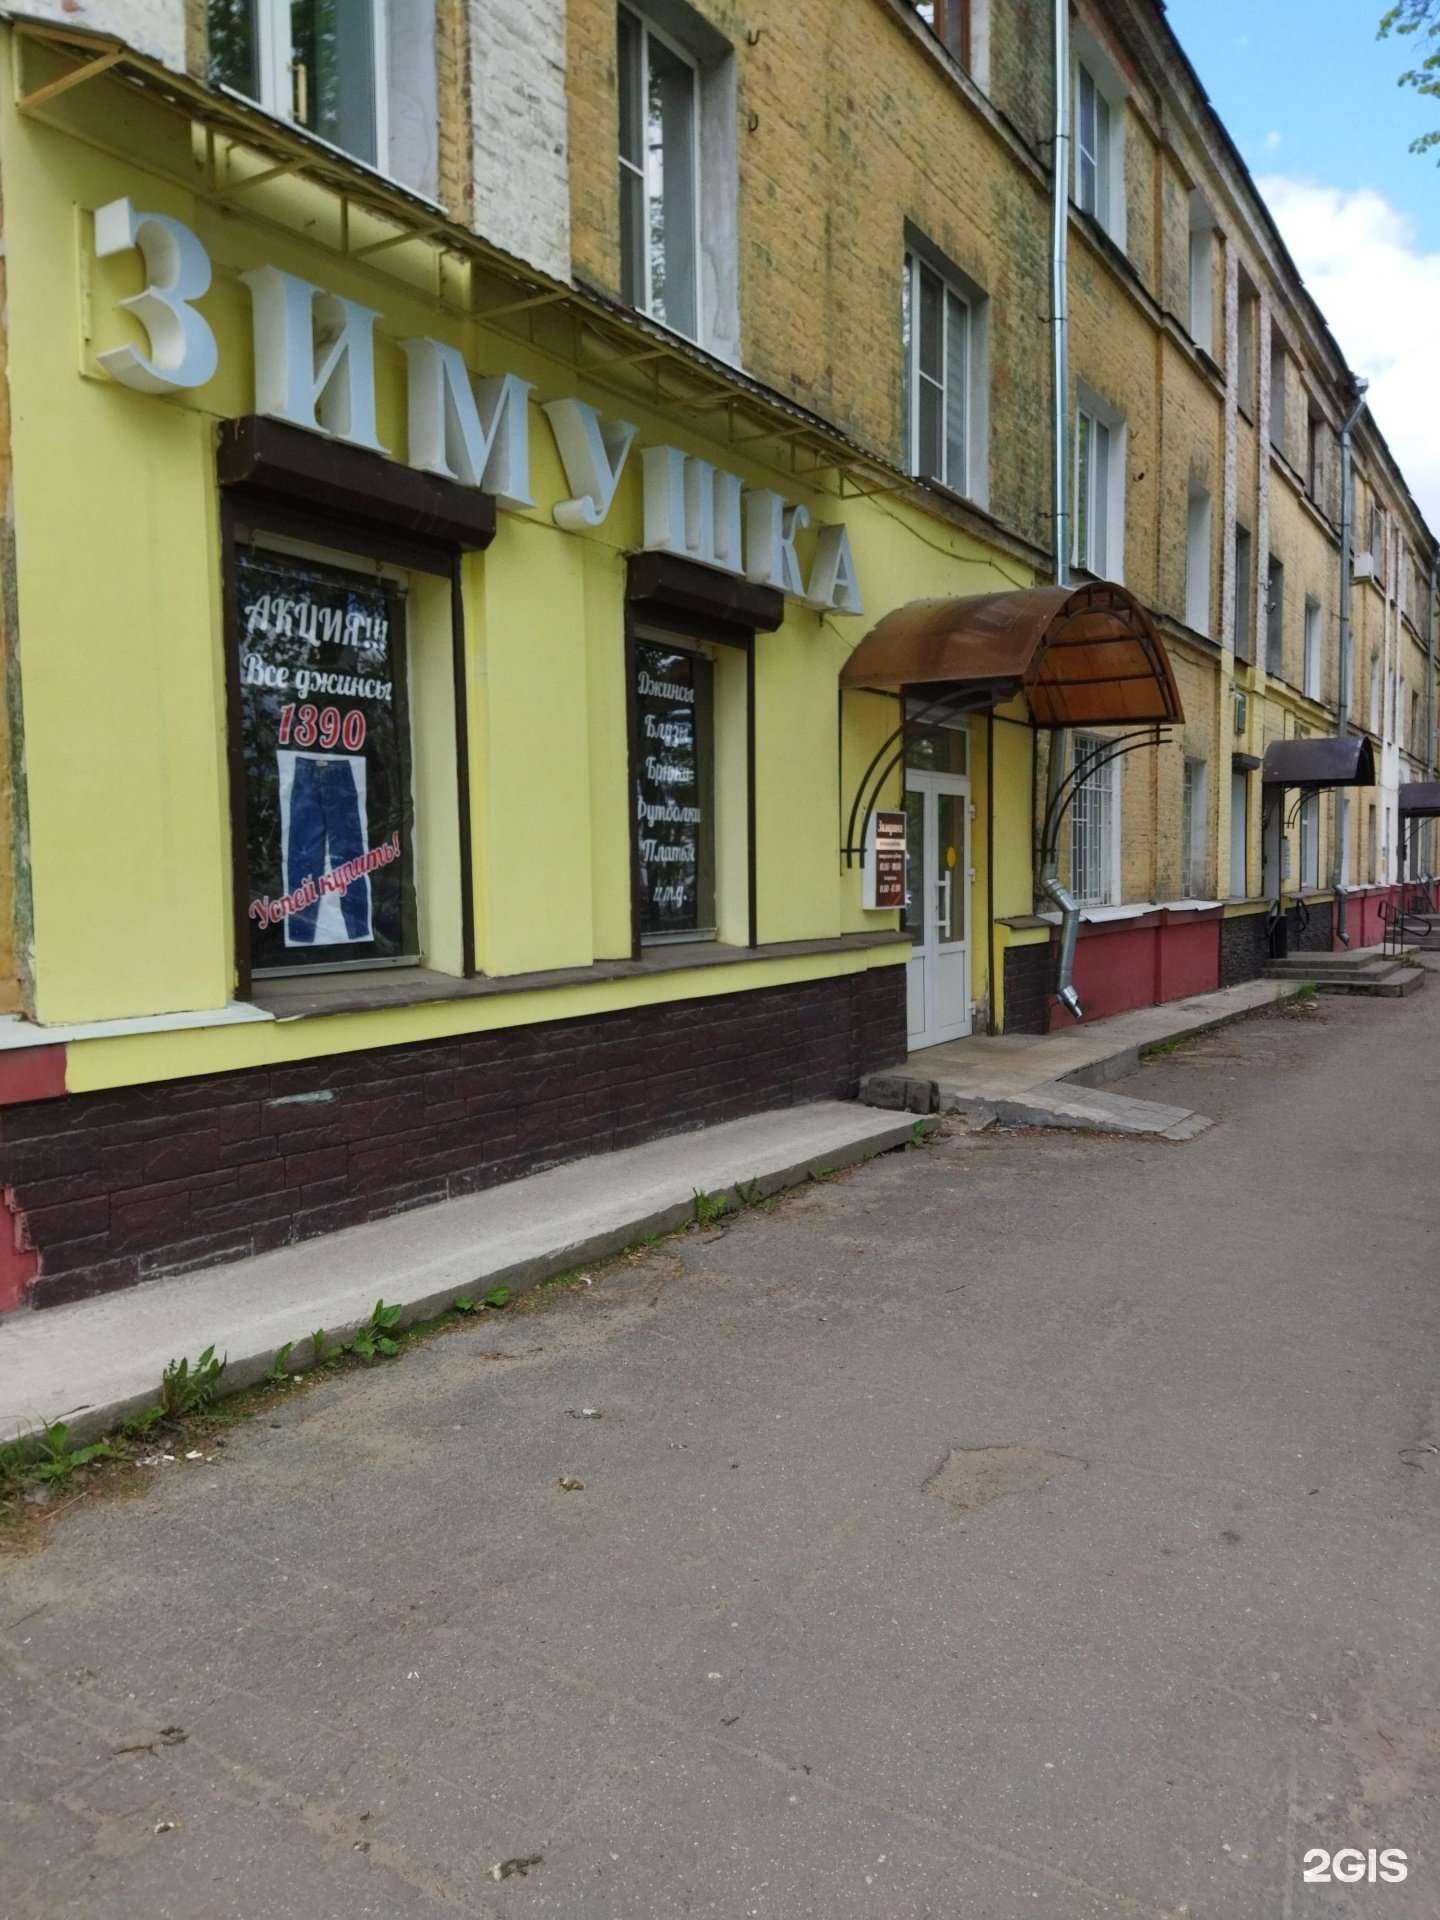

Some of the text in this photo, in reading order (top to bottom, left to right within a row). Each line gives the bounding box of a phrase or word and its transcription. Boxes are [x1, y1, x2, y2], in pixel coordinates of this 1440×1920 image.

[94, 196, 864, 616] ЗИМУШКА
[244, 595, 389, 651] АКЦИЯ!!!
[243, 653, 393, 700] Все джинсы
[638, 671, 694, 703] Джинсы
[278, 702, 366, 751] 1390
[248, 874, 318, 929] Успей
